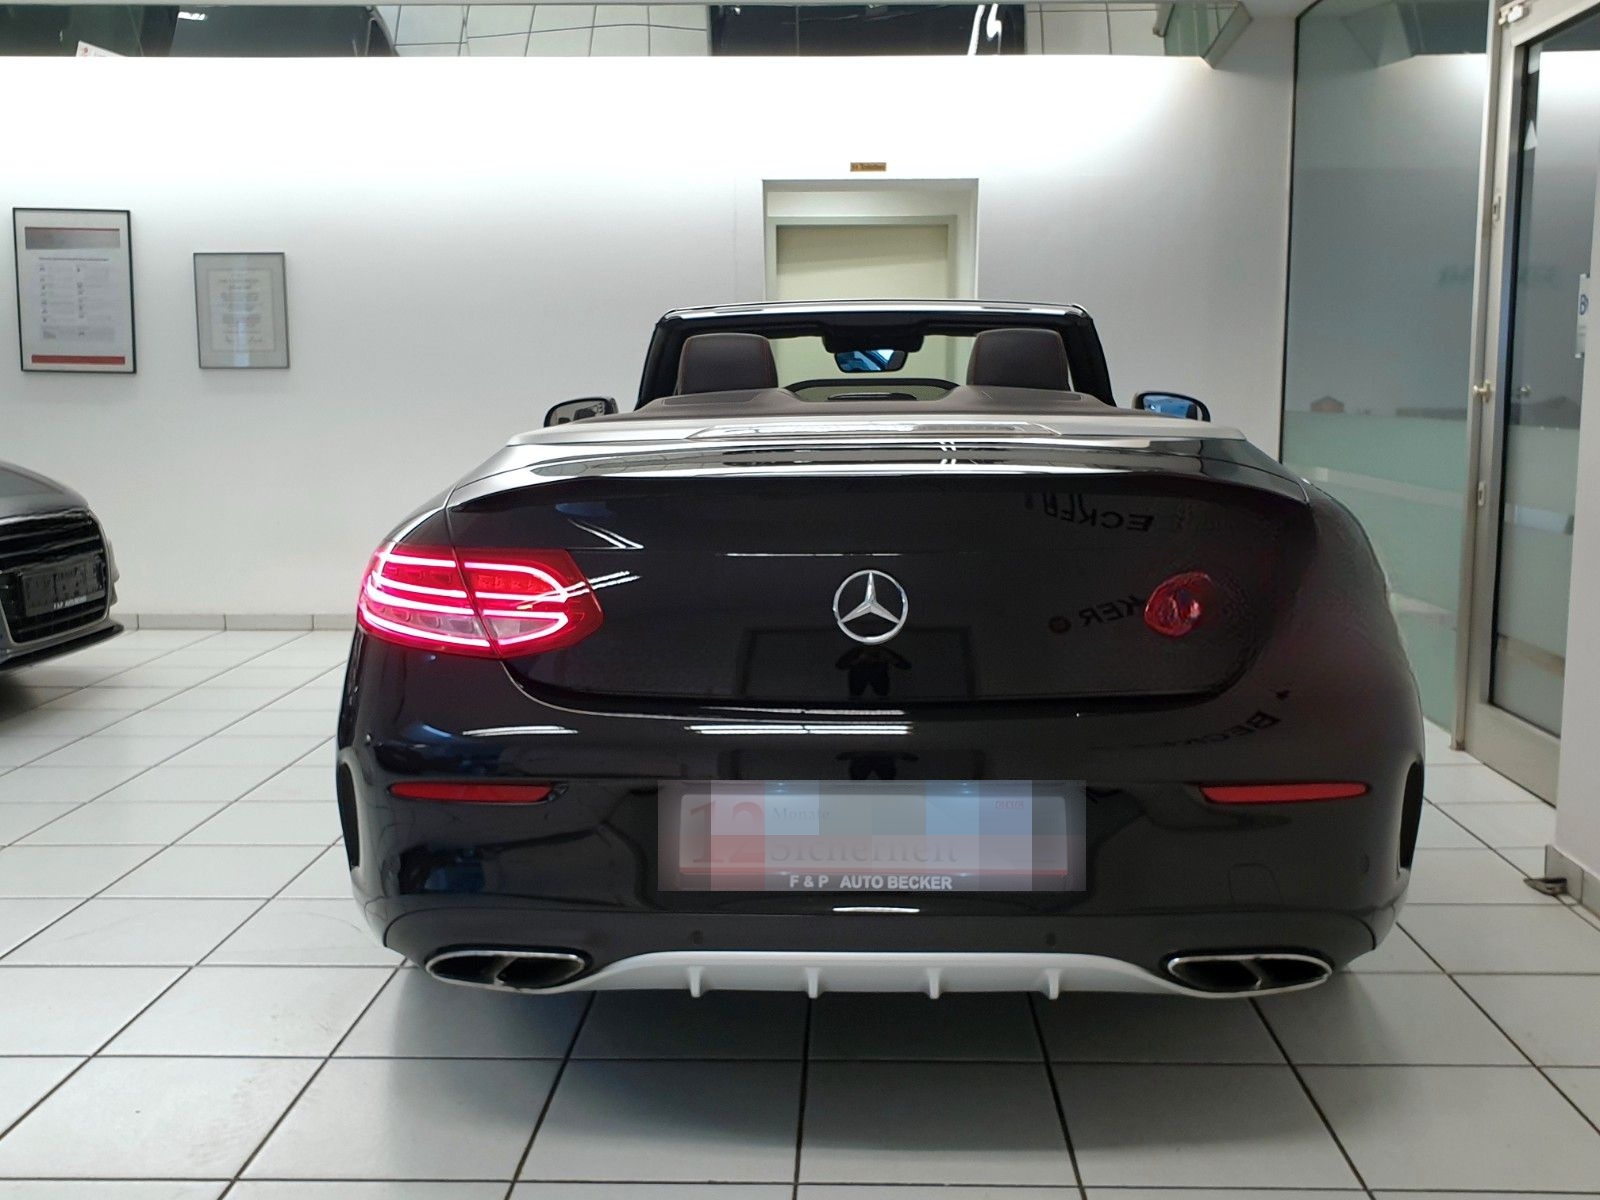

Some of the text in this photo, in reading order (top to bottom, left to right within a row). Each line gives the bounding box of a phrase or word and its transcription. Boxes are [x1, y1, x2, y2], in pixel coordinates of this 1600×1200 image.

[771, 807, 831, 821] Monate
[690, 799, 765, 864] 12
[789, 875, 953, 890] F & P AUTO BECKER
